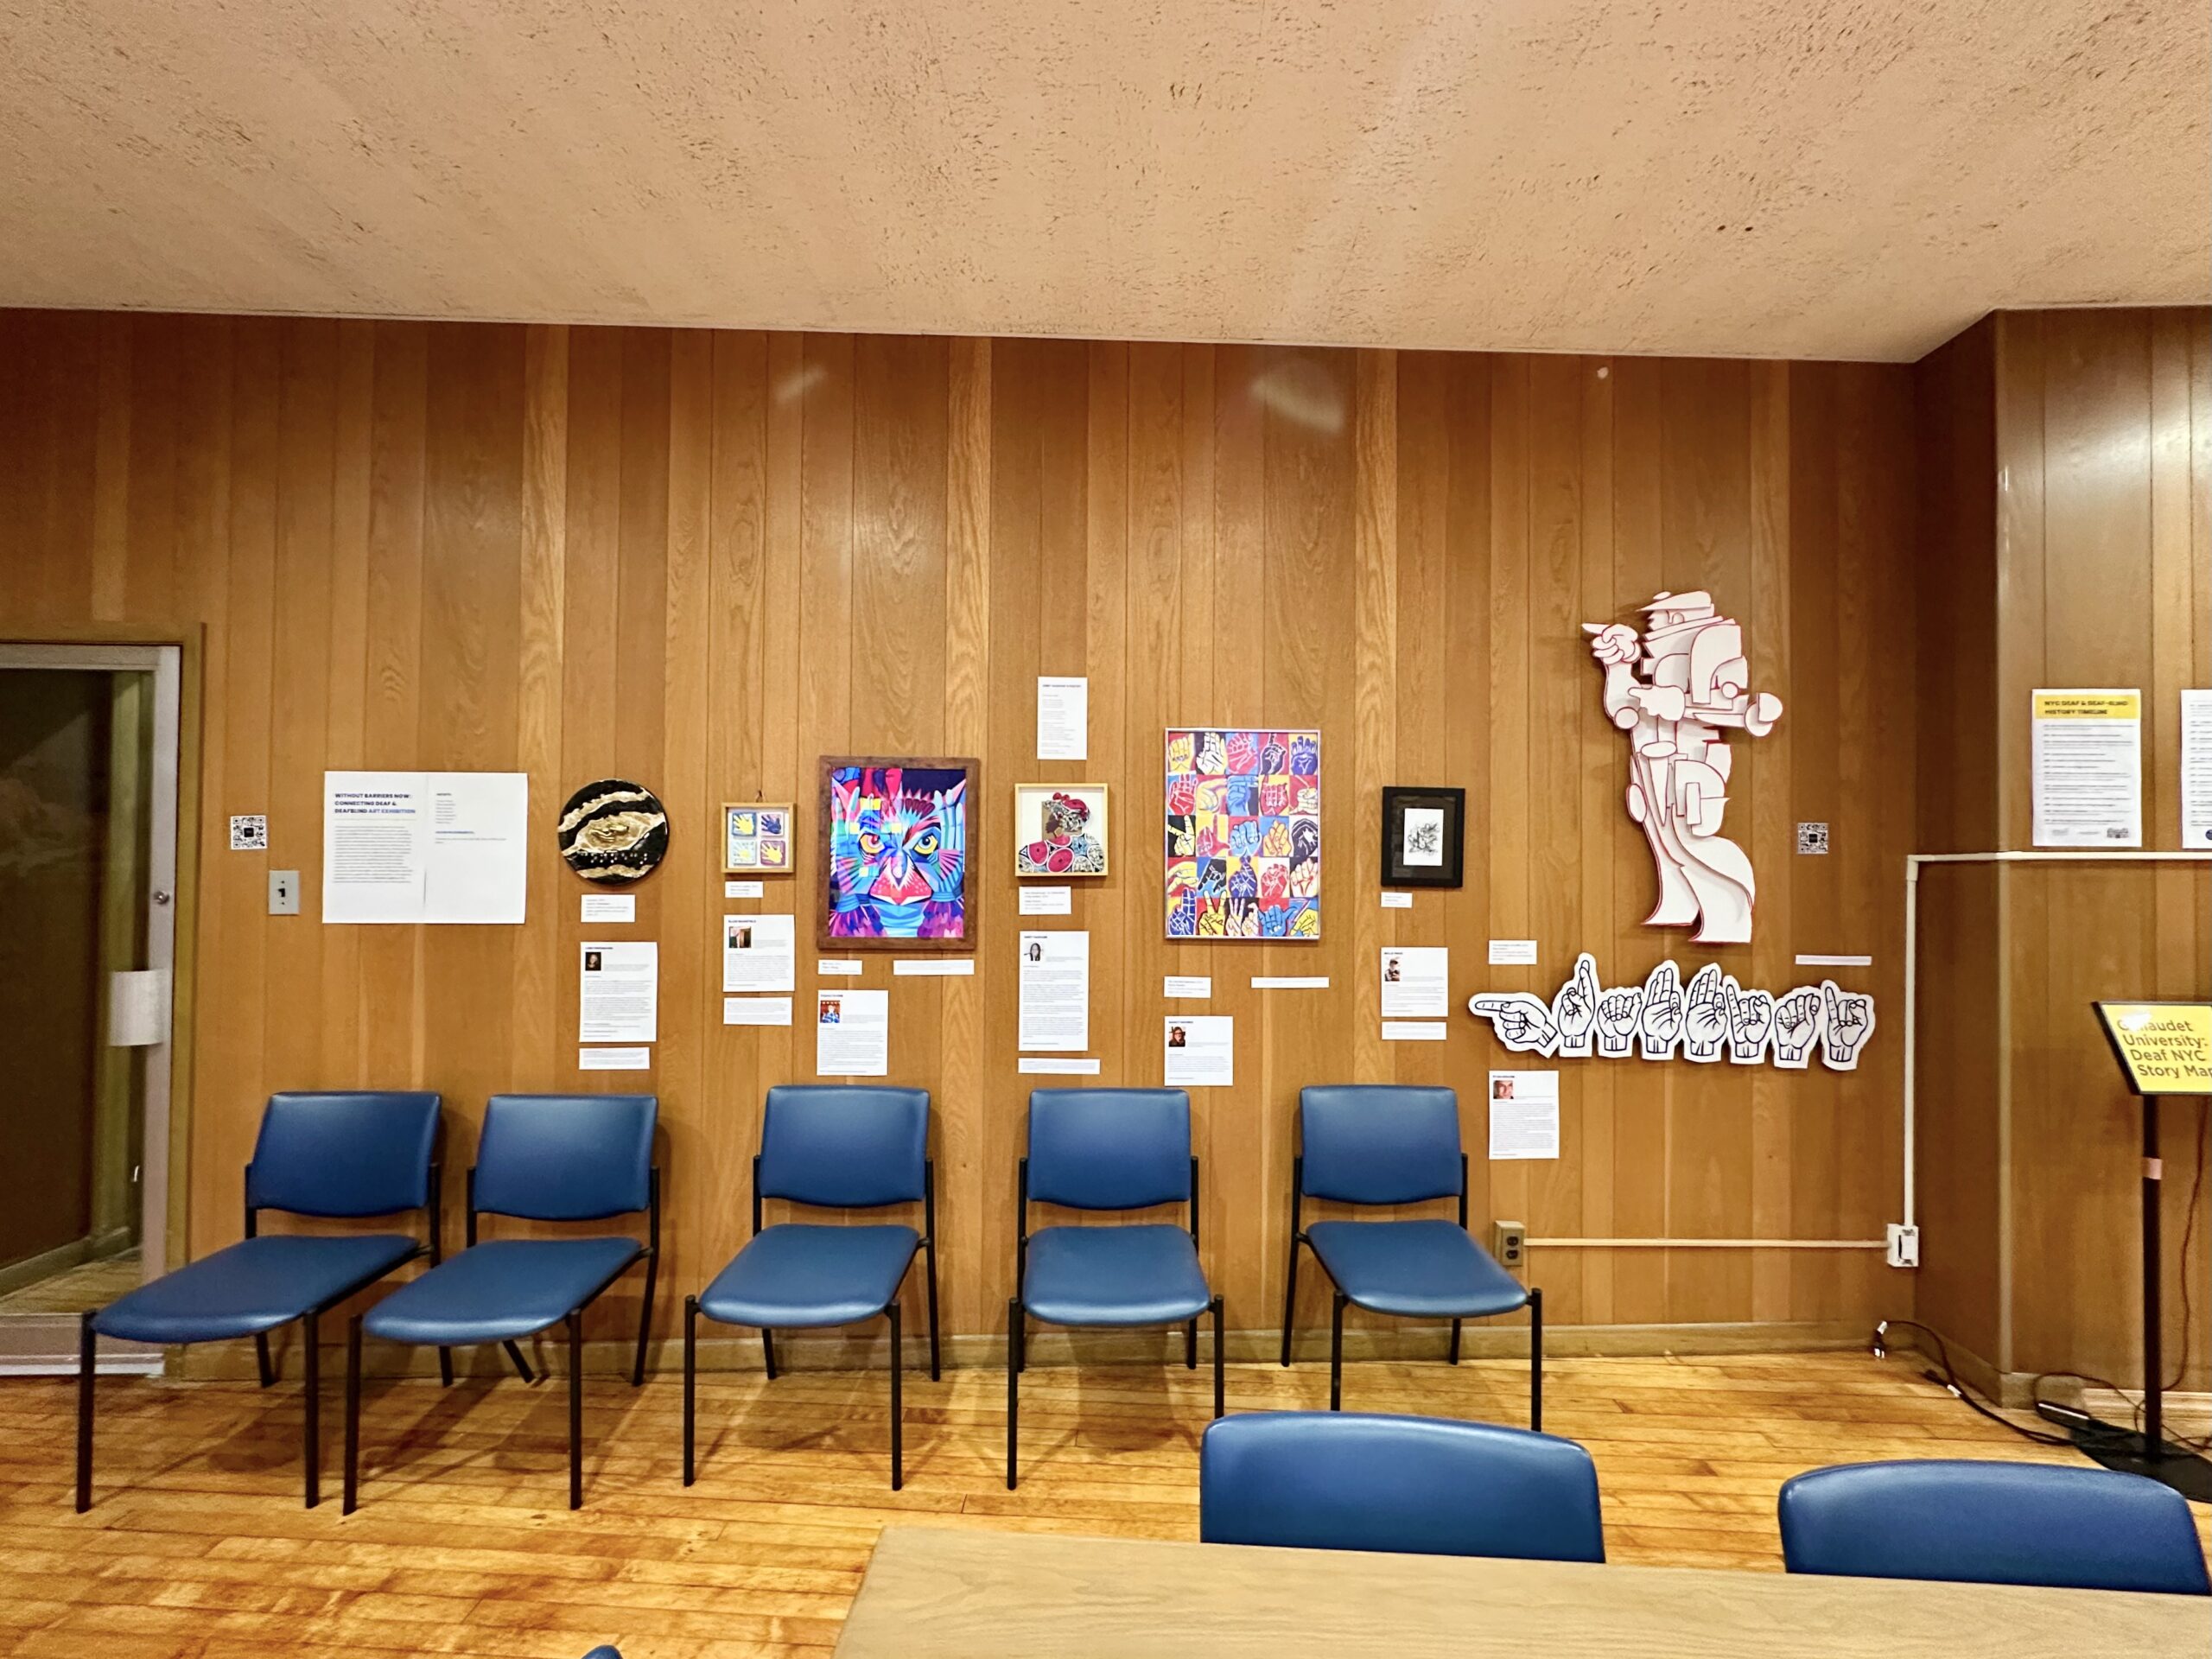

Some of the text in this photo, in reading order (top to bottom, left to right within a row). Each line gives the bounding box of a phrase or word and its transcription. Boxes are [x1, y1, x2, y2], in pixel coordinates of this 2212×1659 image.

[2117, 1020, 2194, 1032] Gaudet
[2130, 1049, 2207, 1062] Deaf NYC
[2137, 1064, 2180, 1079] Story
